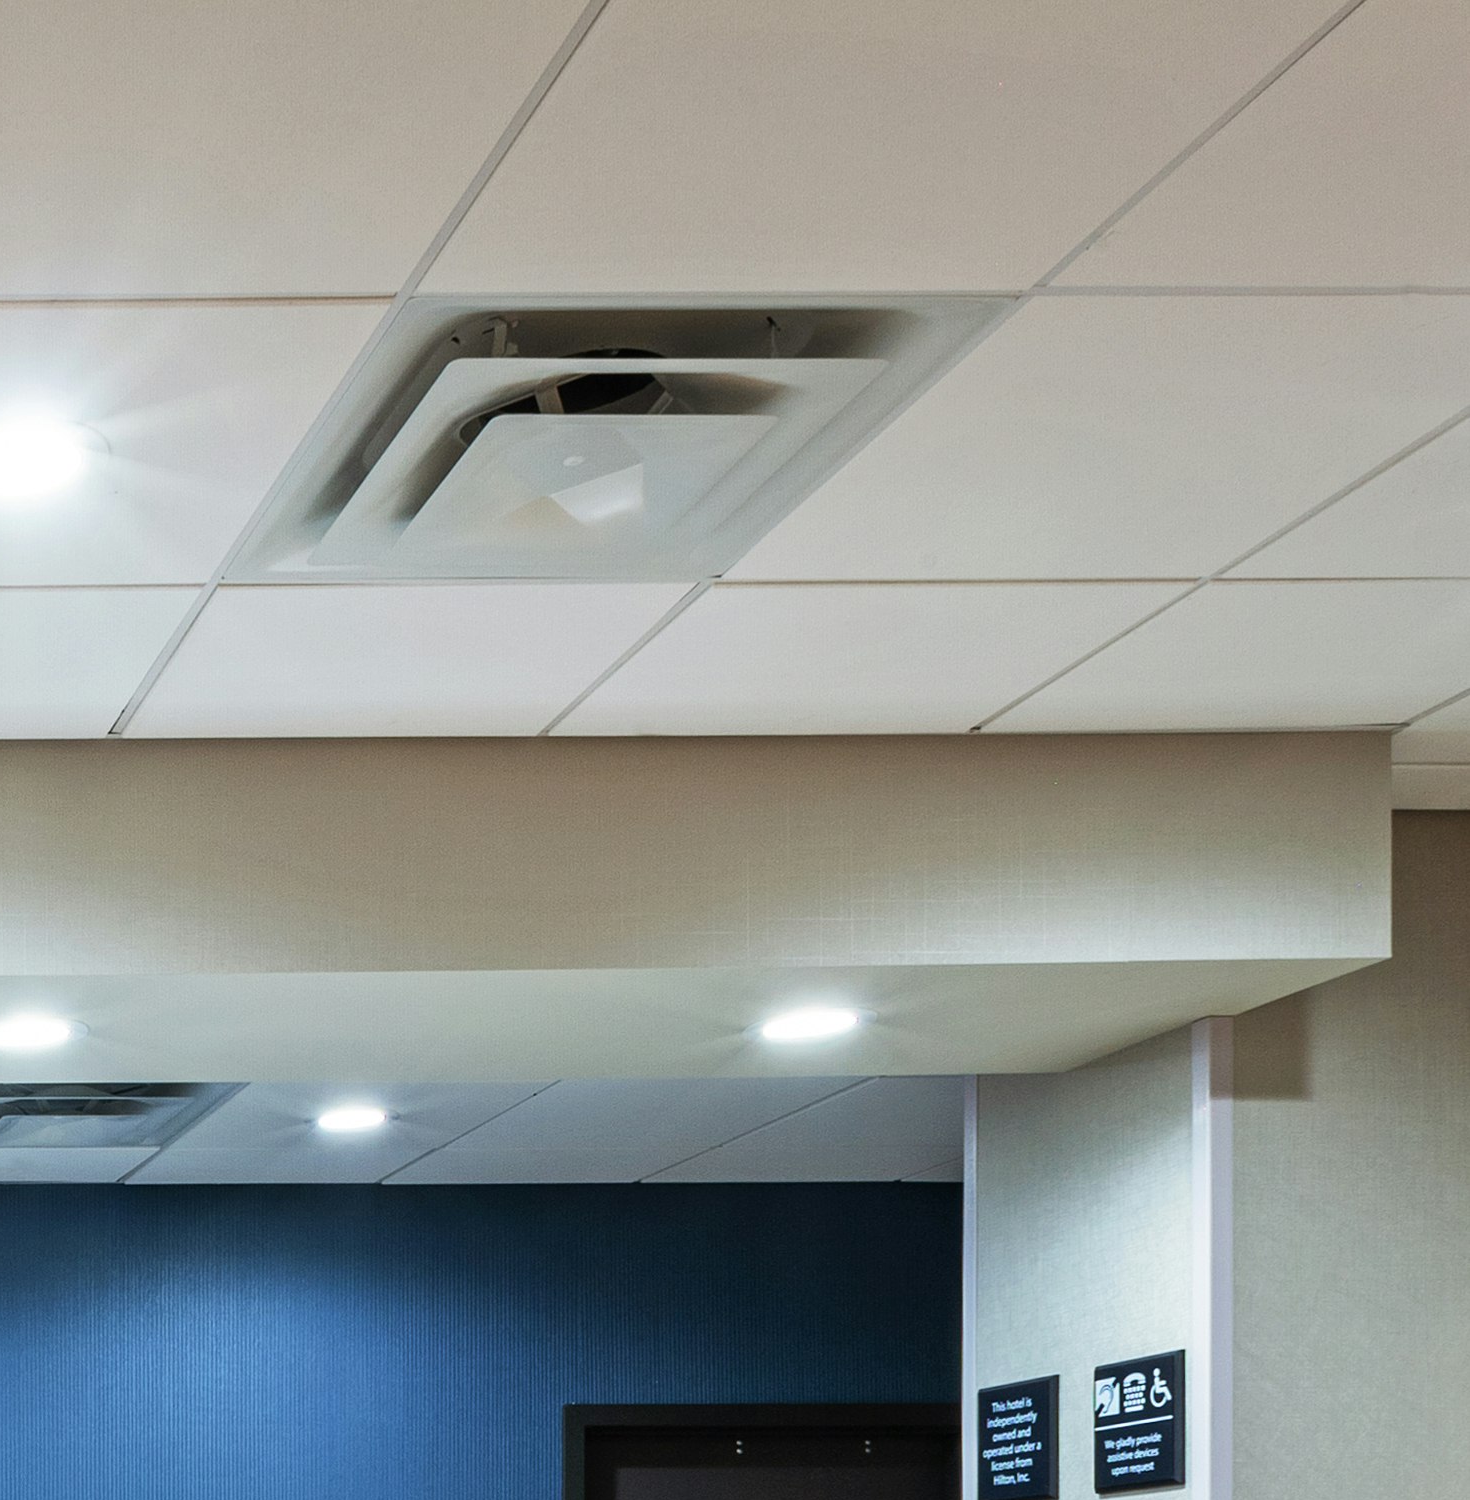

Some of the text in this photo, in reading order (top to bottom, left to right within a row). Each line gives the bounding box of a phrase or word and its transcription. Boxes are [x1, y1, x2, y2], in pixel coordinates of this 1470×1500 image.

[992, 1397, 1032, 1413] This hotel is
[987, 1410, 1037, 1428] independently
[992, 1425, 1031, 1442] owned and
[1104, 1432, 1162, 1450] We gladly provide
[983, 1441, 1042, 1459] operated under a
[1107, 1448, 1159, 1463] assistive devices
[991, 1457, 1033, 1471] license from
[1111, 1462, 1155, 1477] upon request
